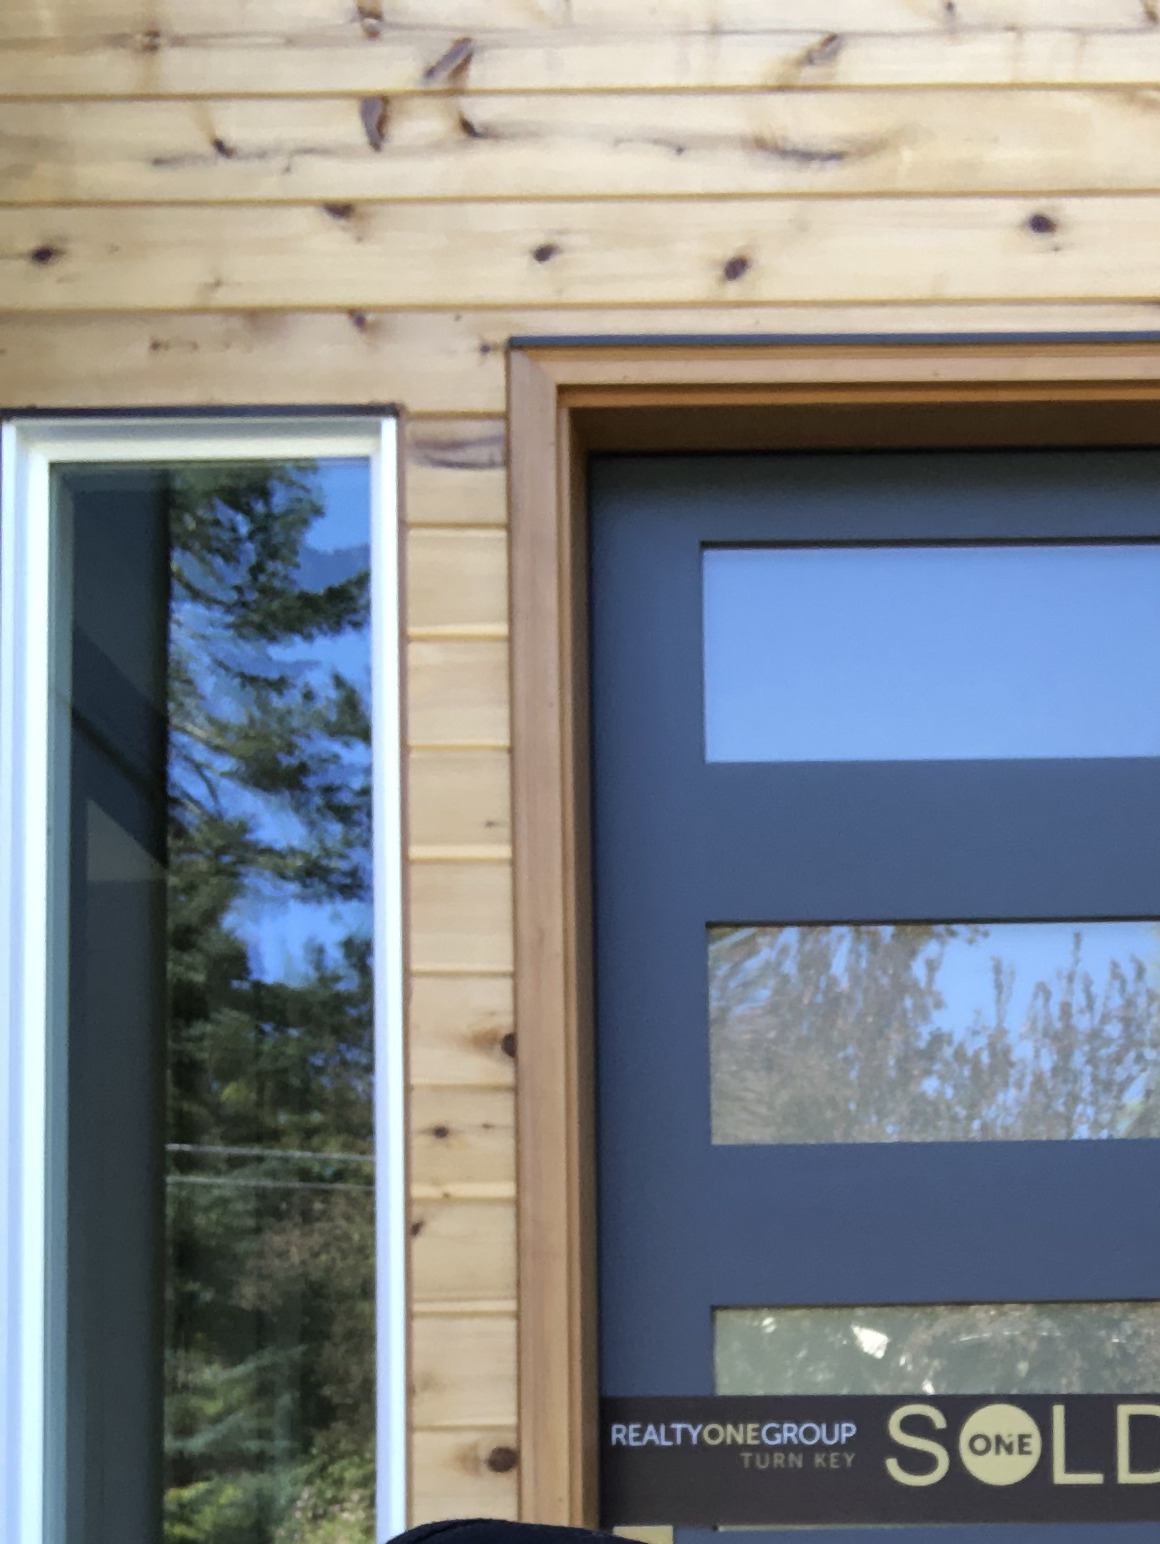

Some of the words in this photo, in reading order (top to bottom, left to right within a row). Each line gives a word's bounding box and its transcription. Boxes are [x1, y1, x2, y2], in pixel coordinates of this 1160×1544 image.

[969, 1432, 1034, 1457] ONE
[740, 1452, 804, 1470] TURN
[813, 1451, 856, 1469] KEY
